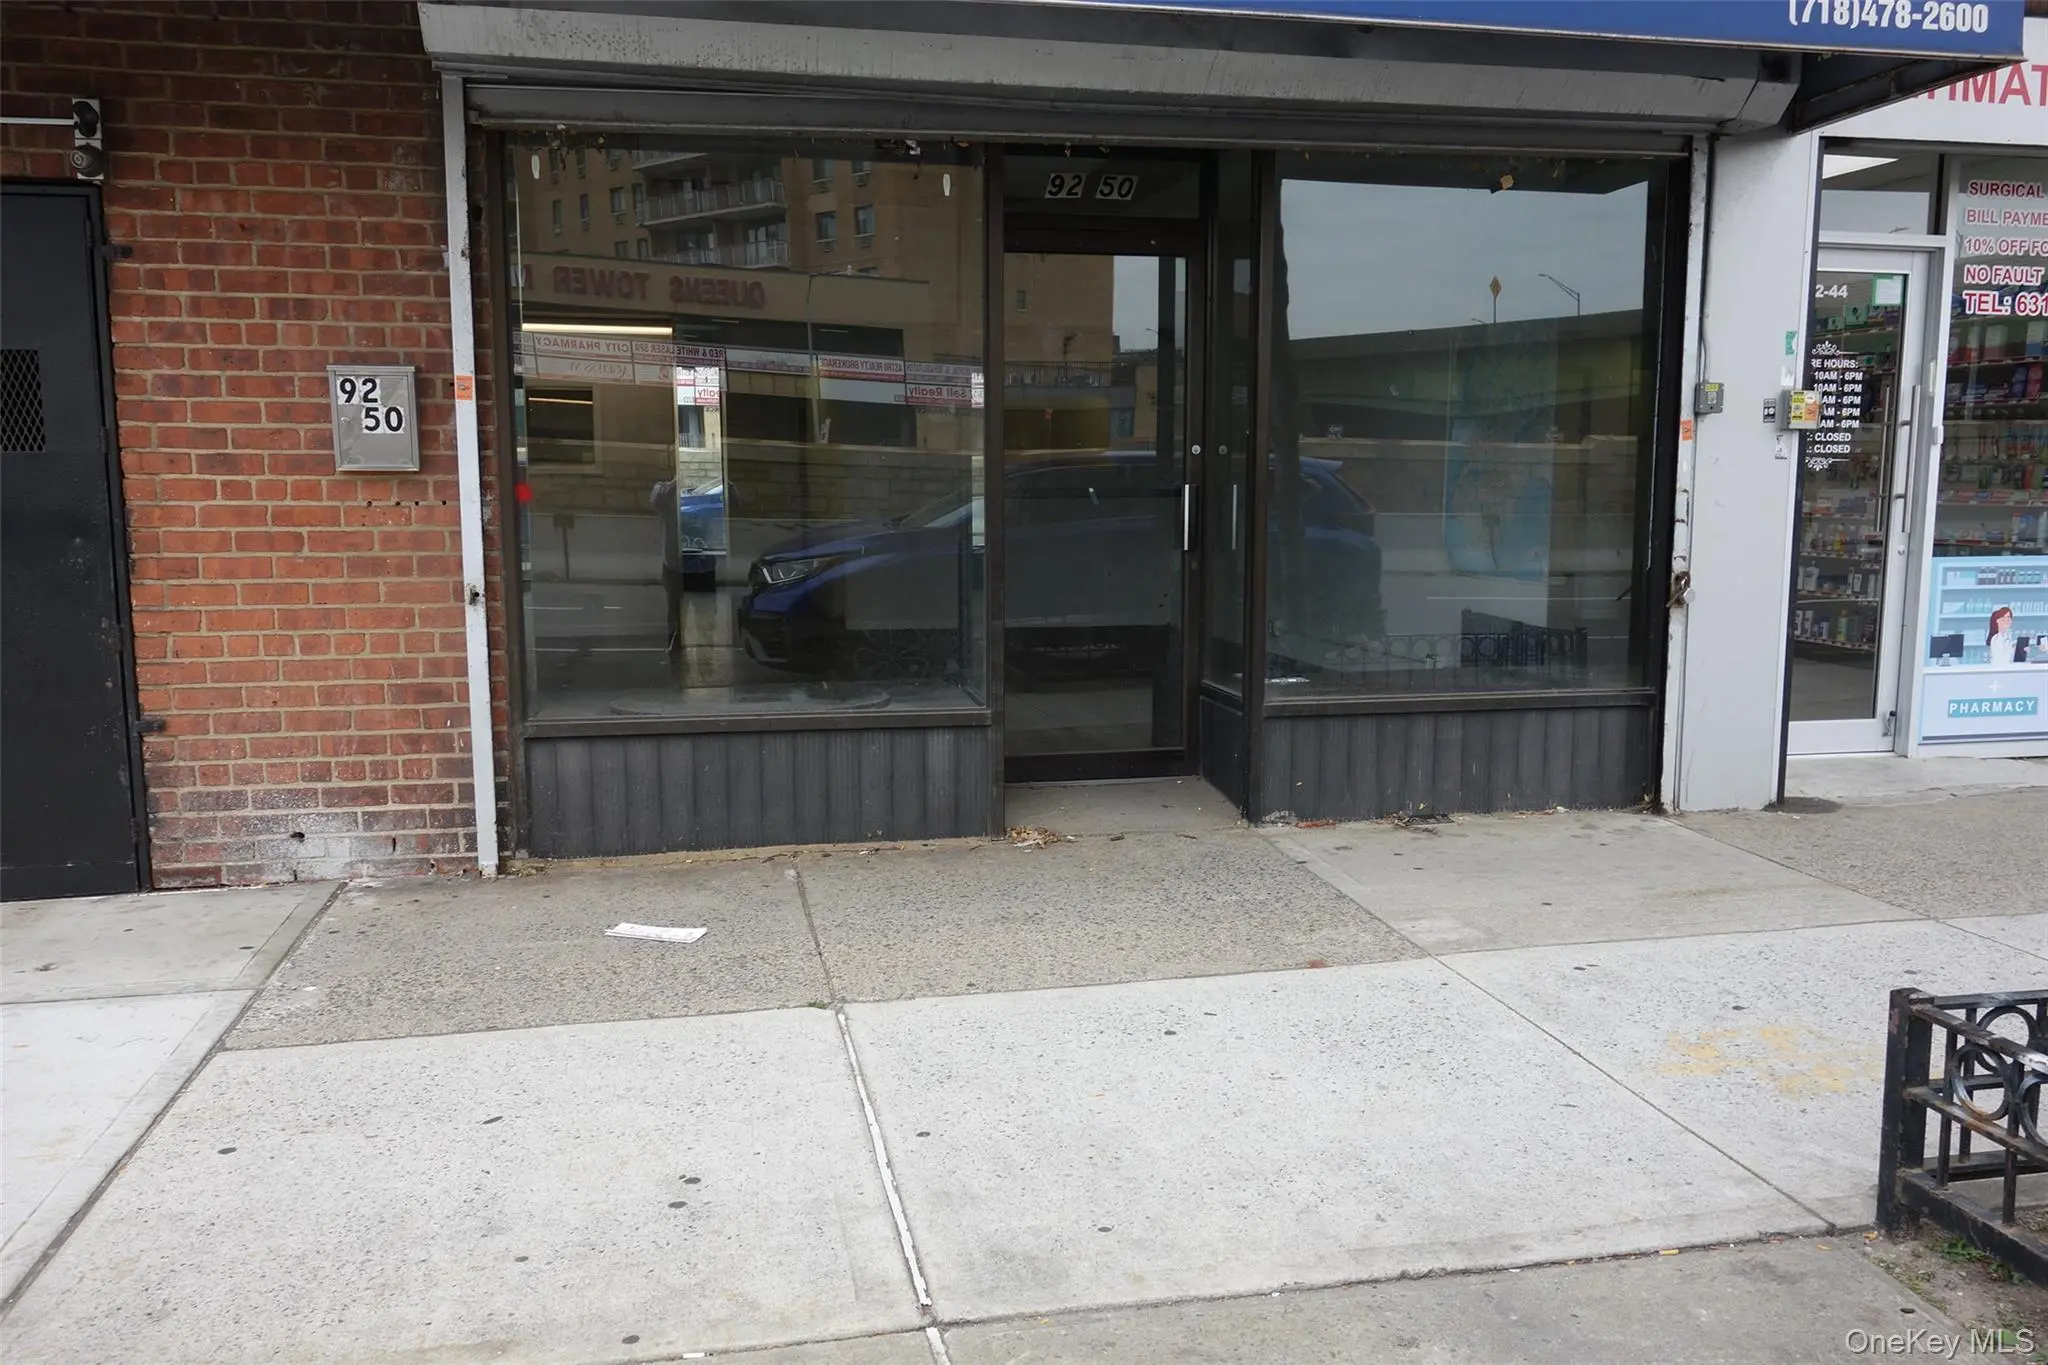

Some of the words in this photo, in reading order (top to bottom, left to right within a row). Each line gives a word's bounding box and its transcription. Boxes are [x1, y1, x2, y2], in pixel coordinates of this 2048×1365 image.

[1788, 0, 1990, 33] (718)478-2600
[1047, 174, 1082, 197] 92
[1099, 176, 1134, 199] 50
[1968, 181, 2044, 198] SURGICAL
[1966, 208, 1998, 224] BILL
[1966, 238, 1995, 254] 10%
[1998, 239, 2029, 255] OFF
[1965, 266, 1989, 283] NO
[1993, 267, 2043, 284] FAULT
[1964, 292, 2011, 313] TEL:
[1824, 359, 1859, 368] HOURS:
[1814, 371, 1837, 380] 10AM
[1844, 372, 1863, 380] 6PM
[340, 377, 379, 404] 92
[1843, 384, 1862, 392] 6PM
[1842, 396, 1861, 404] 6PM
[364, 406, 404, 432] 50
[1841, 408, 1860, 416] 6PM
[1841, 420, 1860, 428] 6PM
[1815, 432, 1852, 441] CLOSED
[1814, 445, 1851, 453] CLOSED
[1949, 700, 2035, 714] PHARMACY
